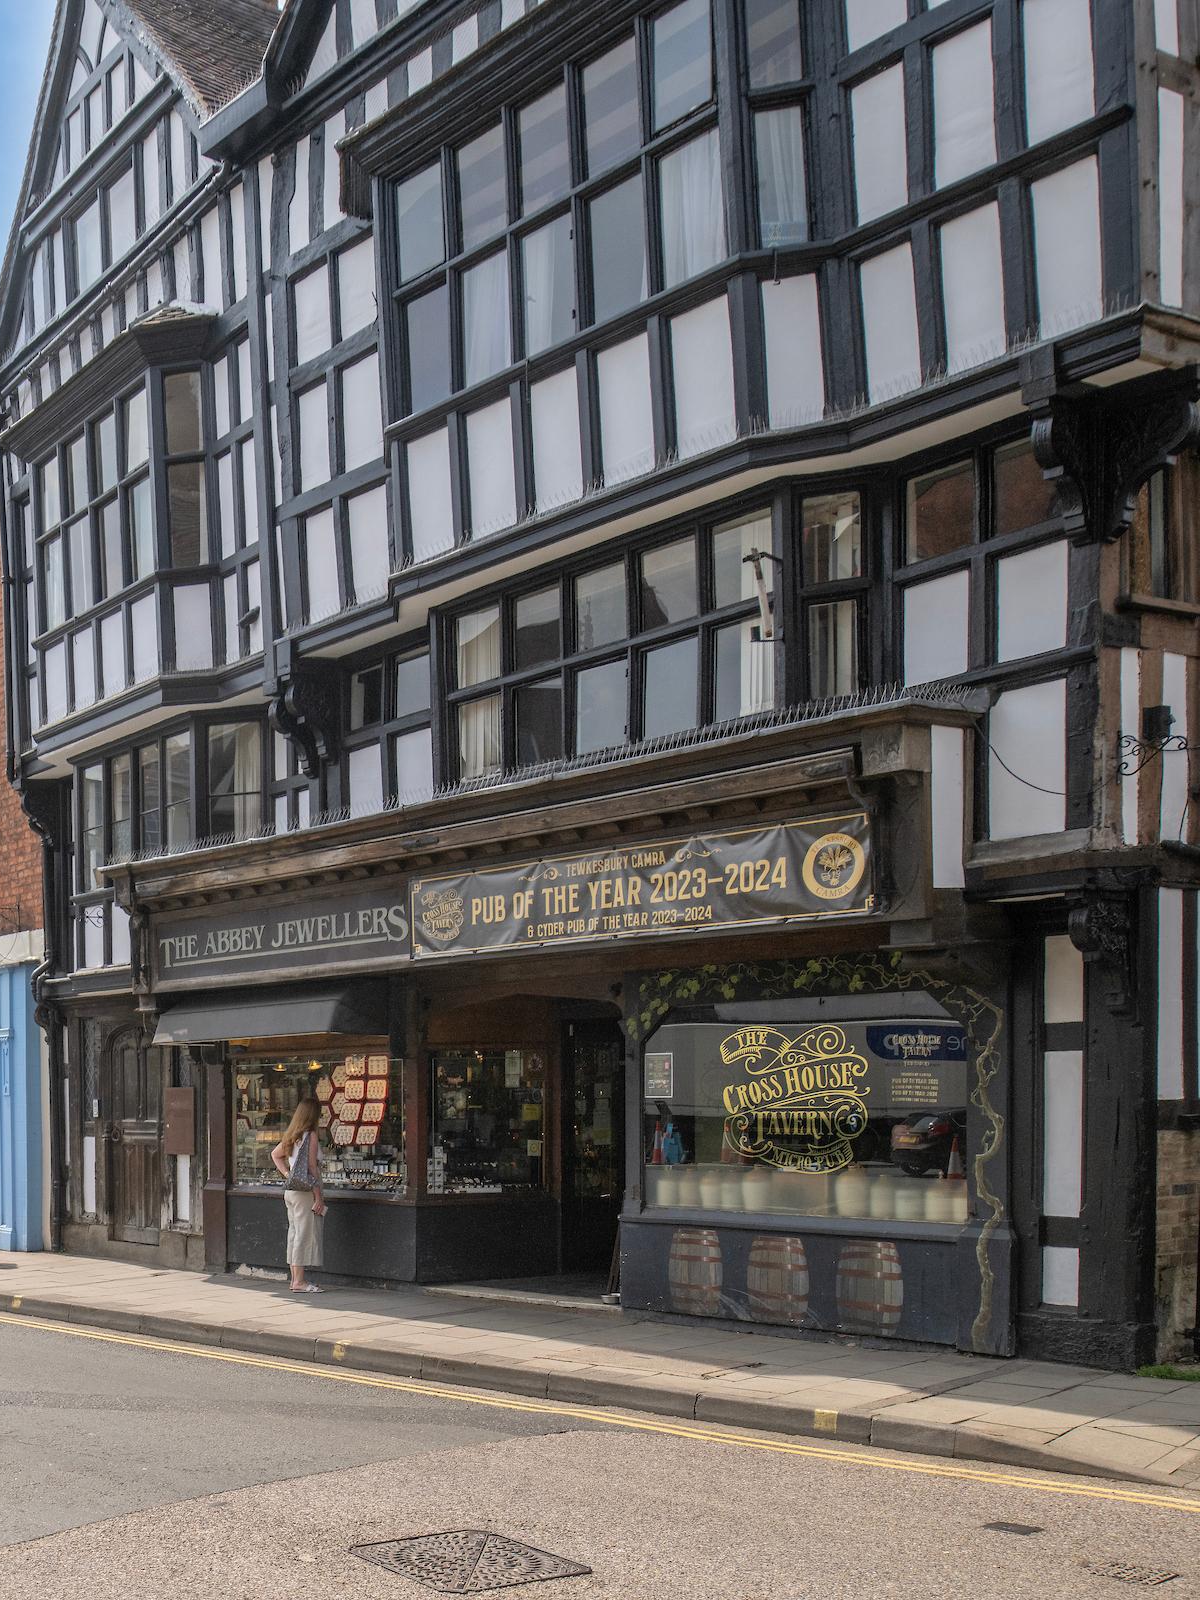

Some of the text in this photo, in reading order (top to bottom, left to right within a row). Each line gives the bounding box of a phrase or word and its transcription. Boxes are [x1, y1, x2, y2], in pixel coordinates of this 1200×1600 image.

[566, 850, 666, 877] TEWKESBURY CAMRA
[471, 856, 787, 925] PUB OF THE YEAR 2023-2024
[160, 904, 409, 968] THE ABBEY JEWELLERS
[527, 904, 712, 938] & CYDER PUB OF THE YEAR 2023-2024
[735, 1031, 768, 1049] THE
[723, 1062, 855, 1114] CROSS HOUSE
[751, 1110, 834, 1146] TAVERN
[773, 1147, 812, 1171] MICRO
[814, 1149, 846, 1171] PUB
